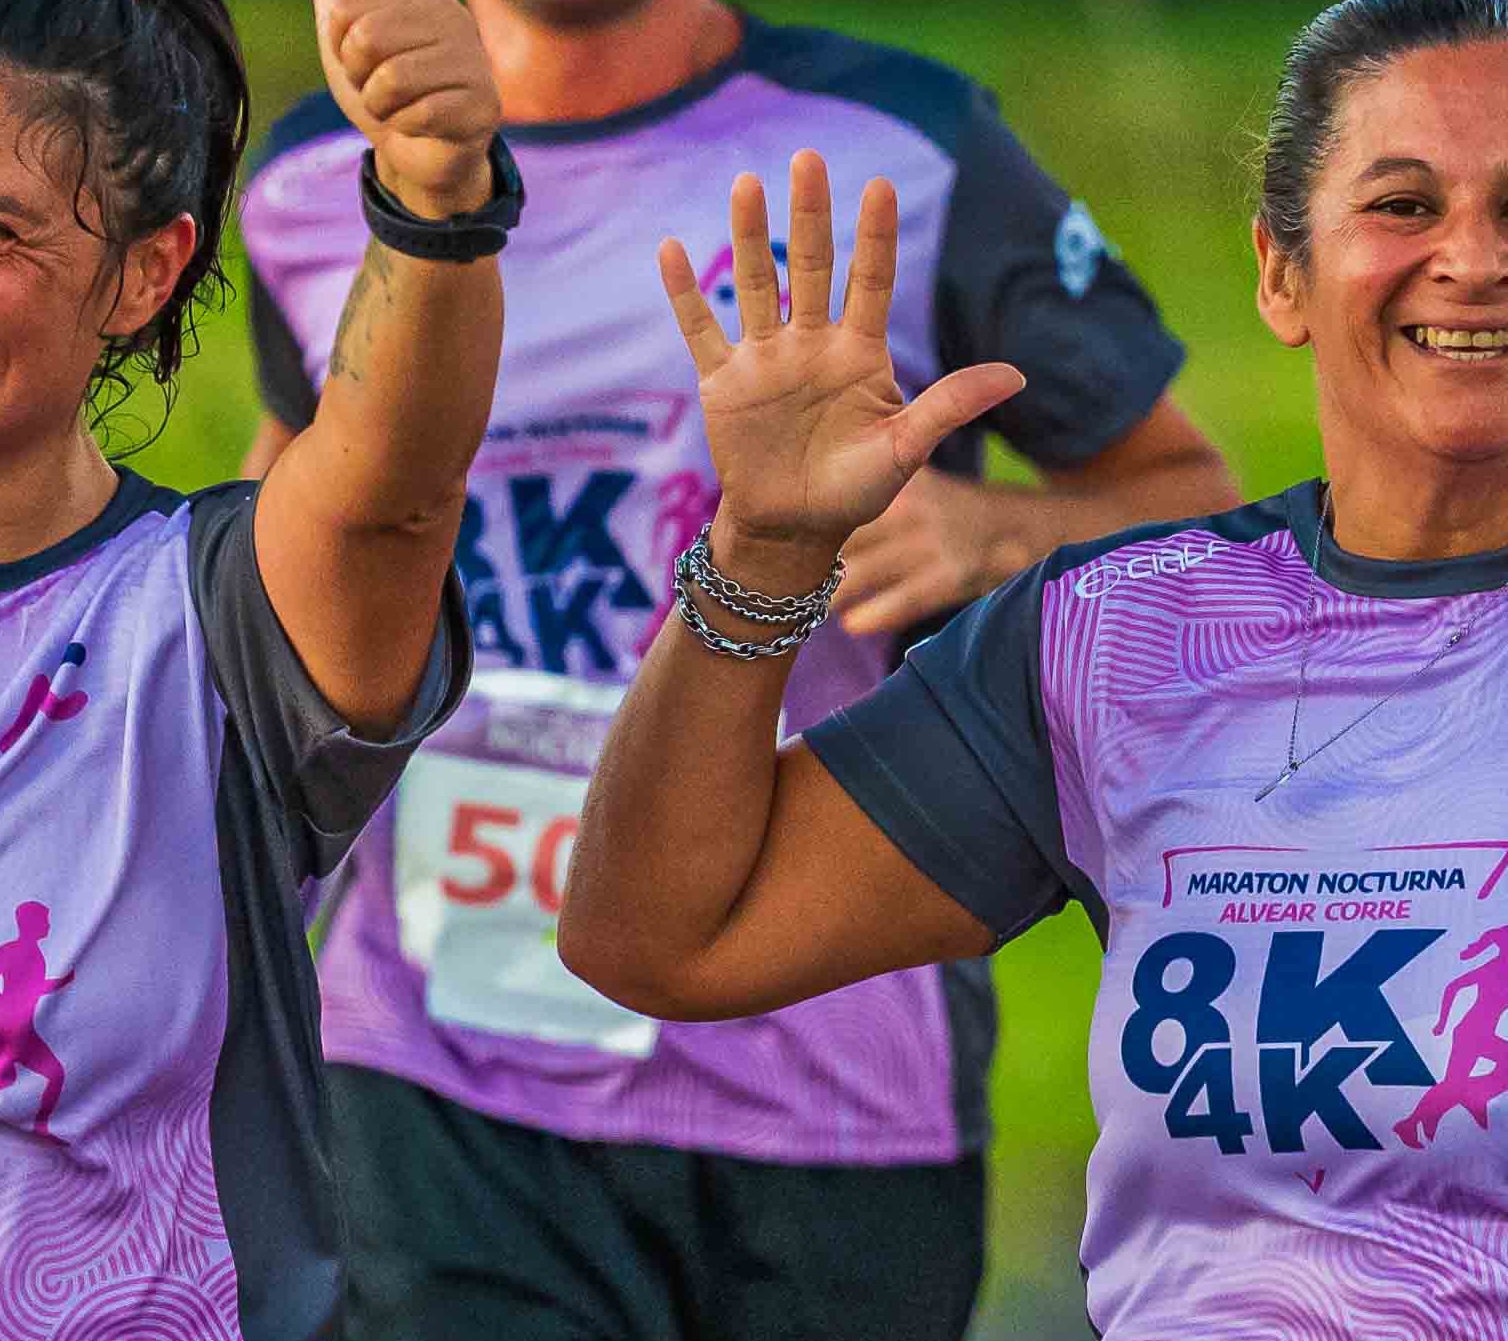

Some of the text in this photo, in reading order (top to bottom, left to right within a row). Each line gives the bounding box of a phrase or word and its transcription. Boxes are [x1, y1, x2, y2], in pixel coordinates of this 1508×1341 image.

[438, 800, 578, 913] 50
[1187, 868, 1467, 896] MARATON NOCTURNA
[1218, 899, 1414, 924] ALVEAR CORRE
[1120, 928, 1448, 1095] 8K
[1163, 1046, 1386, 1156] 4K
